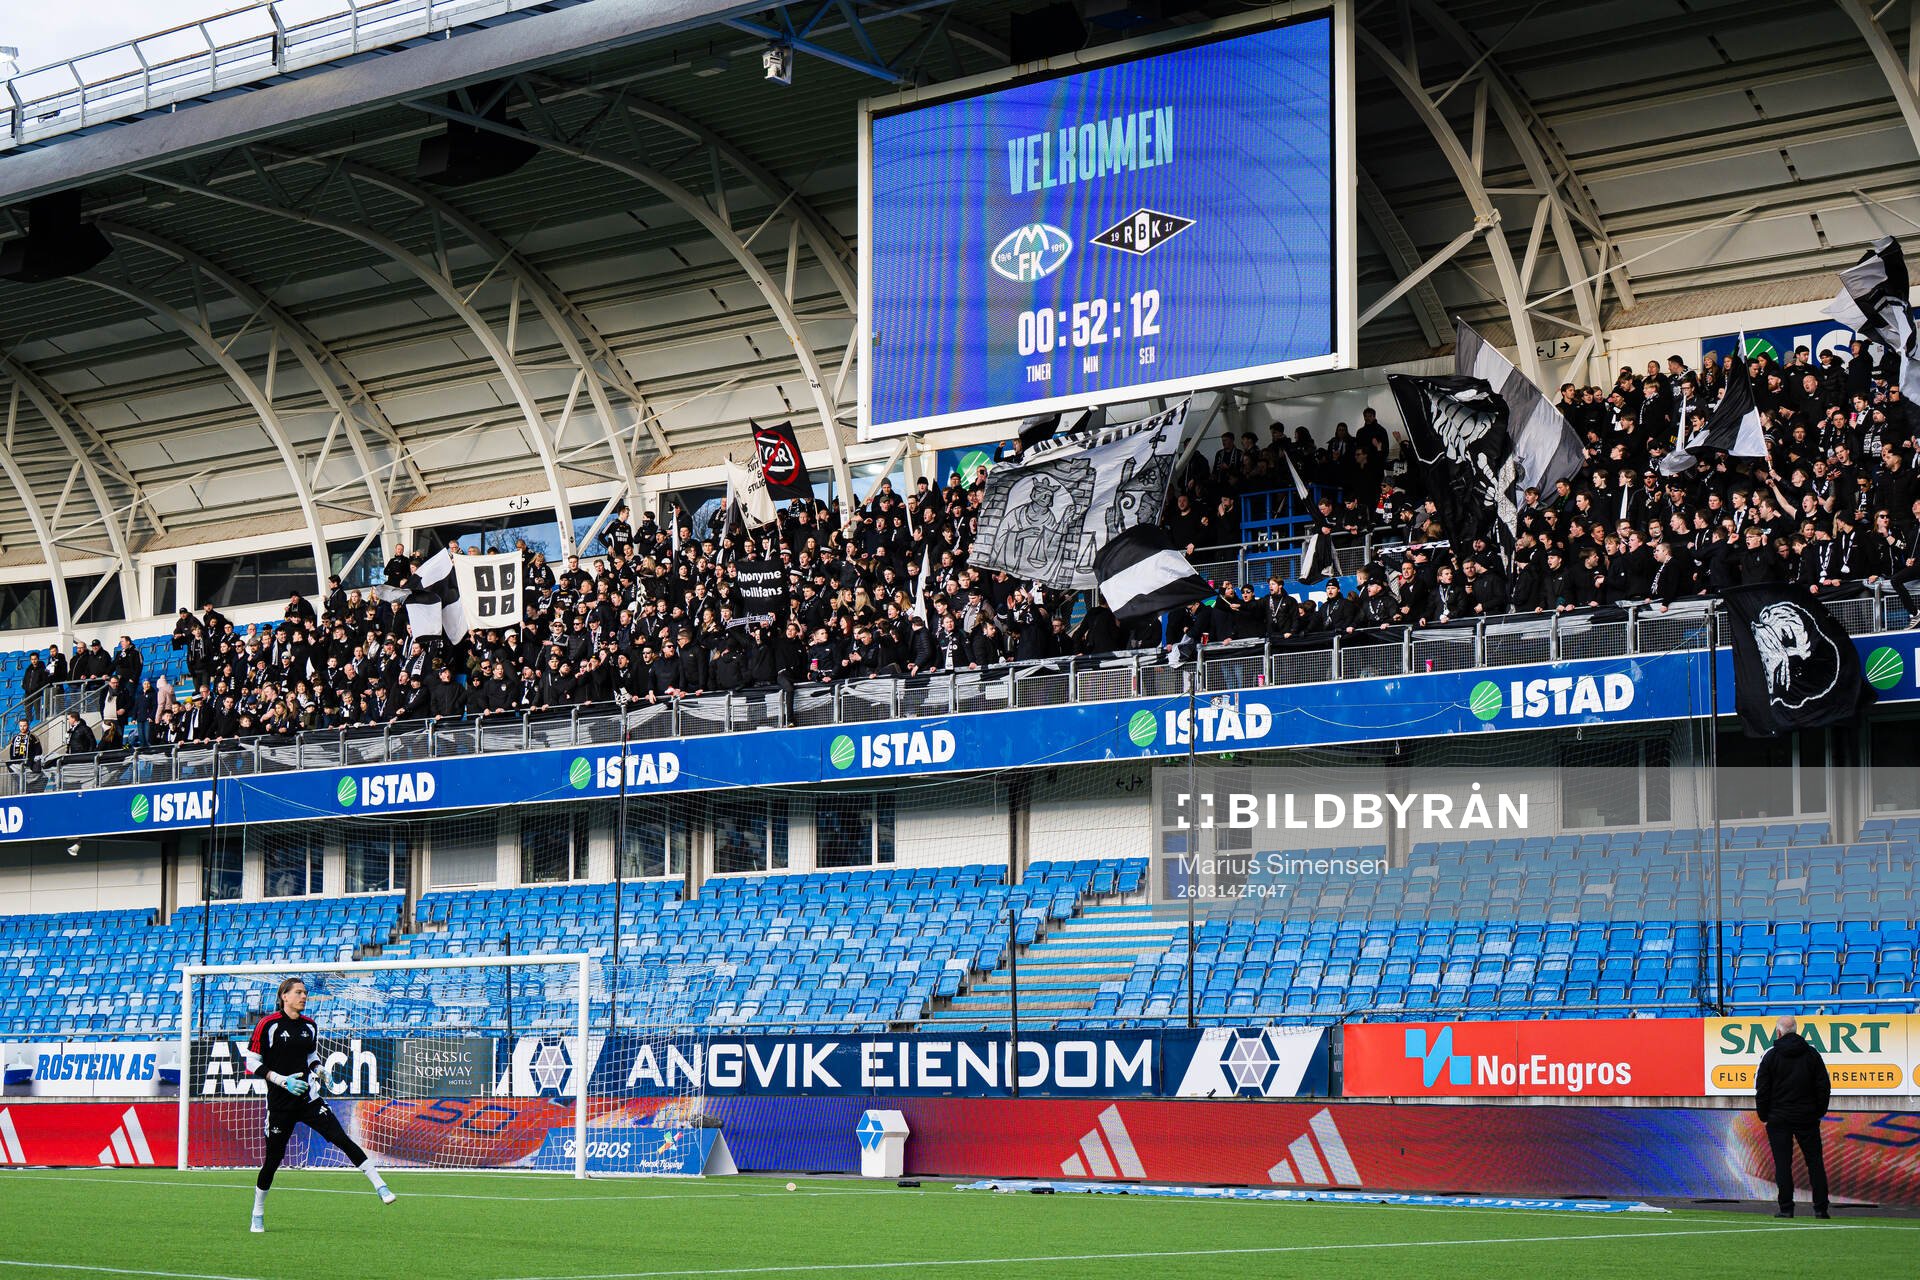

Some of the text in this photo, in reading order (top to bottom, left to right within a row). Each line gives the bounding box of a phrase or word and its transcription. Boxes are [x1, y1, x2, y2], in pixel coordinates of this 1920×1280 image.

[1008, 106, 1174, 195] VELKOMMEN
[1026, 347, 1155, 383] TIMER MIN SEK
[480, 572, 513, 588] 1 9
[737, 570, 782, 584] Anonyme
[483, 600, 511, 615] 1 7
[1510, 673, 1635, 719] ISTAD
[1165, 703, 1273, 746] ISTAD
[861, 729, 956, 769] ISTAD
[596, 752, 680, 789] ISTAD
[360, 771, 436, 806] ISTAD
[153, 791, 219, 823] ISTAD
[36, 1053, 157, 1080] ROSTEIN AS
[415, 1051, 472, 1063] CLASSIC
[415, 1066, 473, 1077] NORWAY
[625, 1039, 1152, 1088] ANGVIK EIENDOM
[1477, 1054, 1631, 1092] NorEngros
[1720, 1072, 1895, 1081] FLIS RSENTER
